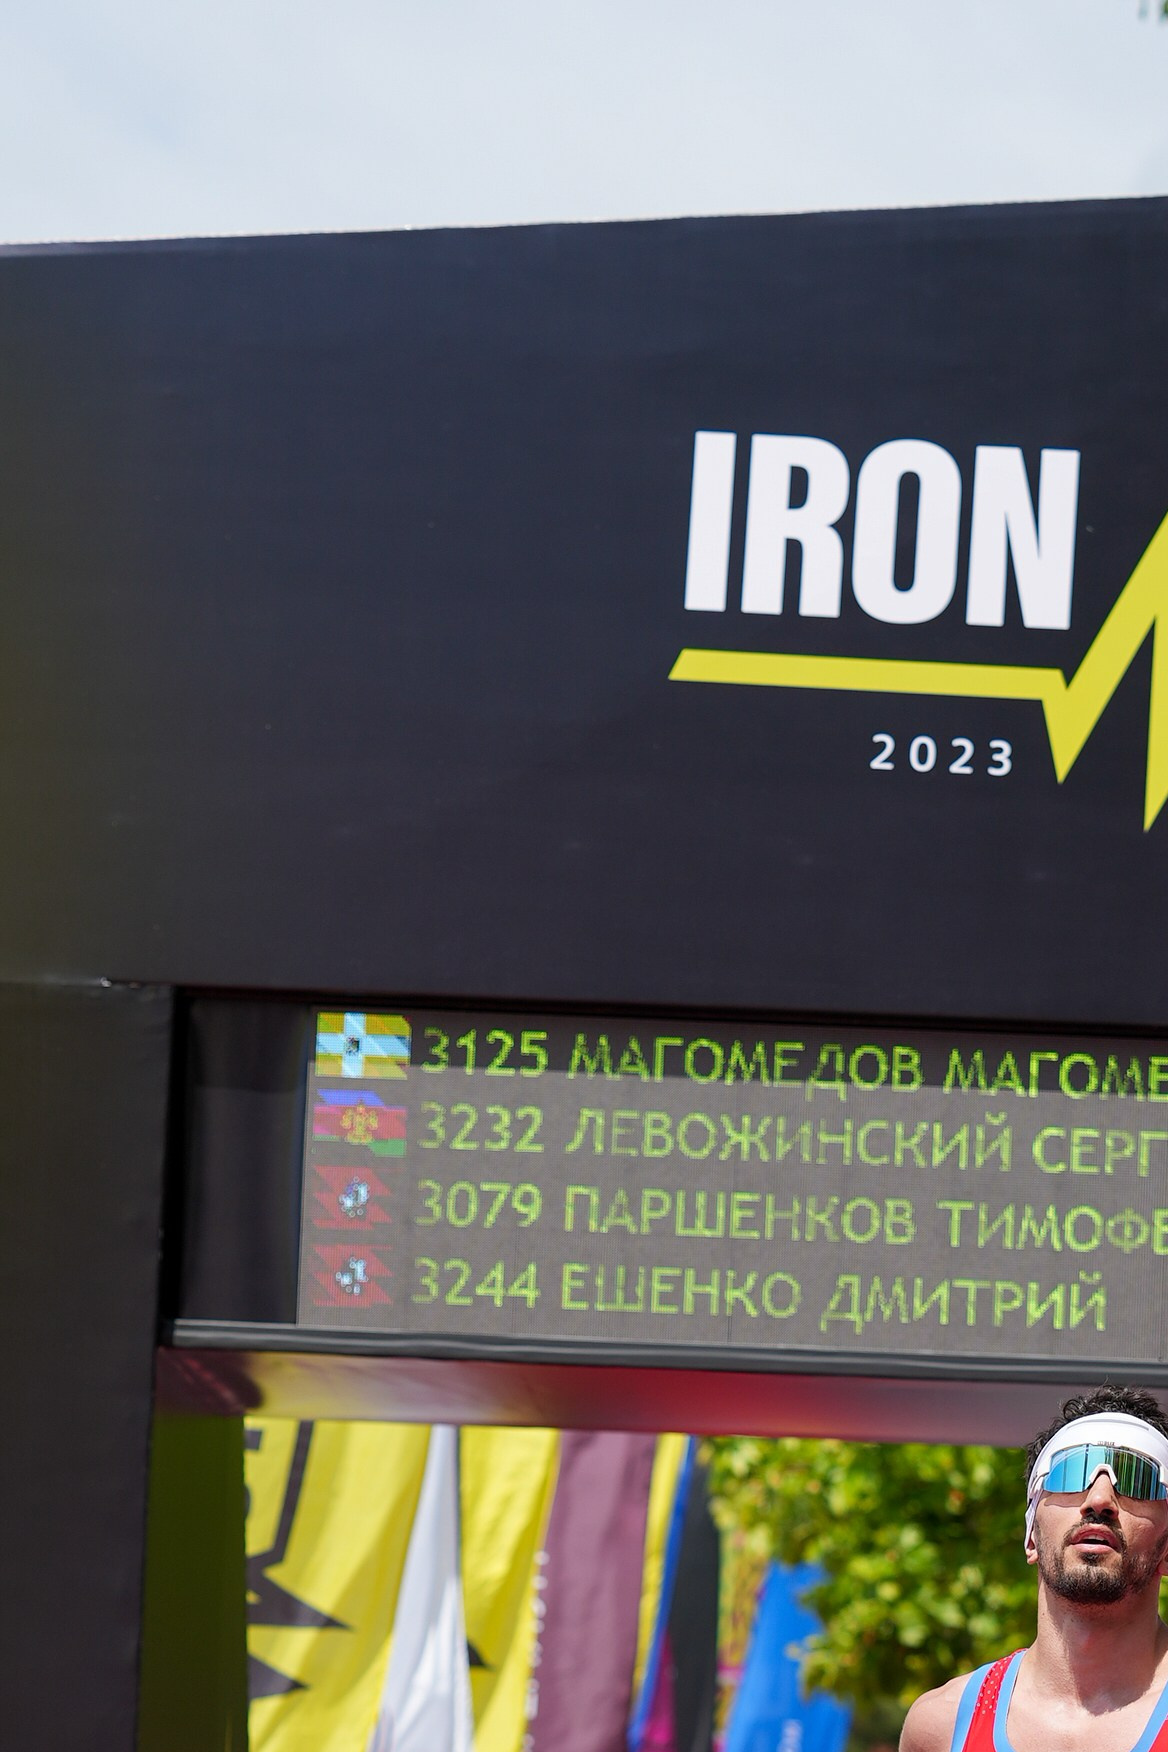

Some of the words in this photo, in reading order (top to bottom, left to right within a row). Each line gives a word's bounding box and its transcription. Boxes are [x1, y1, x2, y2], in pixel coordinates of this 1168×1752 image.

[684, 430, 1080, 630] IRON
[870, 733, 1014, 777] 2023
[421, 1028, 549, 1077] 3125
[567, 1033, 924, 1102] МАГОМЕДОВ
[418, 1101, 545, 1153] 3232
[566, 1107, 1012, 1172] ЛЕВОЖИНСКИЙ
[415, 1179, 542, 1229] 3079
[565, 1184, 916, 1246] ПАРШЕНКОВ
[411, 1256, 541, 1308] 3244
[562, 1262, 801, 1319] ЕШЕНКО
[821, 1270, 1107, 1335] ДМИТРИЙ
